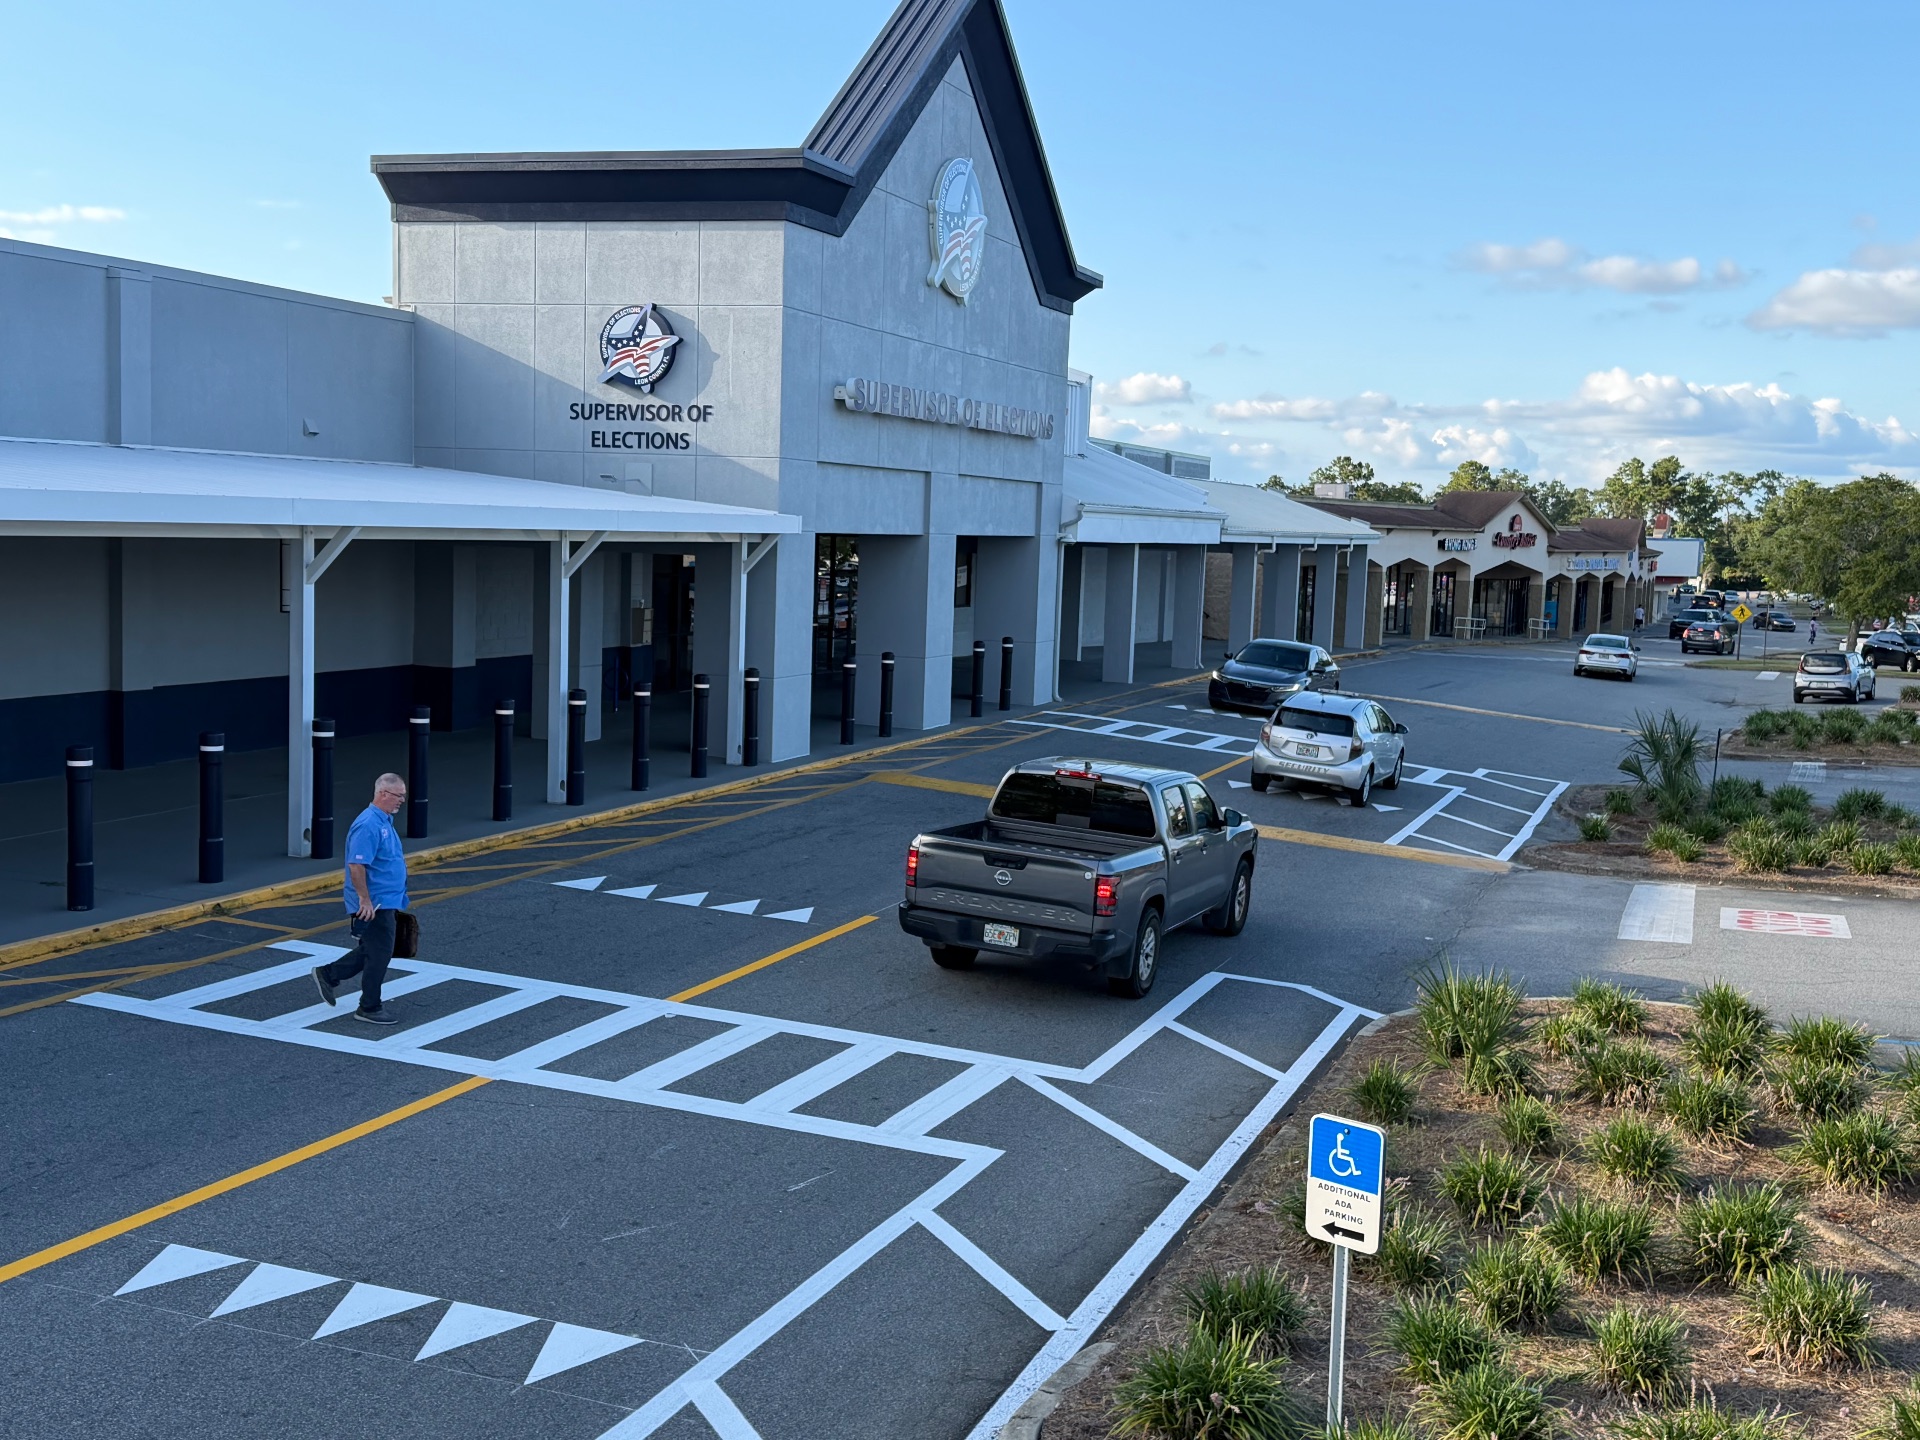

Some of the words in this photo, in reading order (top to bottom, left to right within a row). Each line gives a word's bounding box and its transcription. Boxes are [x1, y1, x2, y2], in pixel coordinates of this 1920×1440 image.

[601, 325, 611, 359] SUPERVISOR
[614, 306, 641, 321] ELECTIONS
[569, 402, 682, 421] SUPERVISOR
[687, 404, 713, 423] OF
[848, 377, 959, 425] SUPERVISOR
[961, 397, 982, 428] OF
[985, 402, 1054, 440] ELECTIONS
[591, 431, 690, 450] ELECTIONS
[1278, 760, 1330, 775] SECURITY
[1317, 1182, 1371, 1203] ADDITIONAL
[1335, 1199, 1352, 1210] ADA
[1324, 1208, 1363, 1225] PARKING
